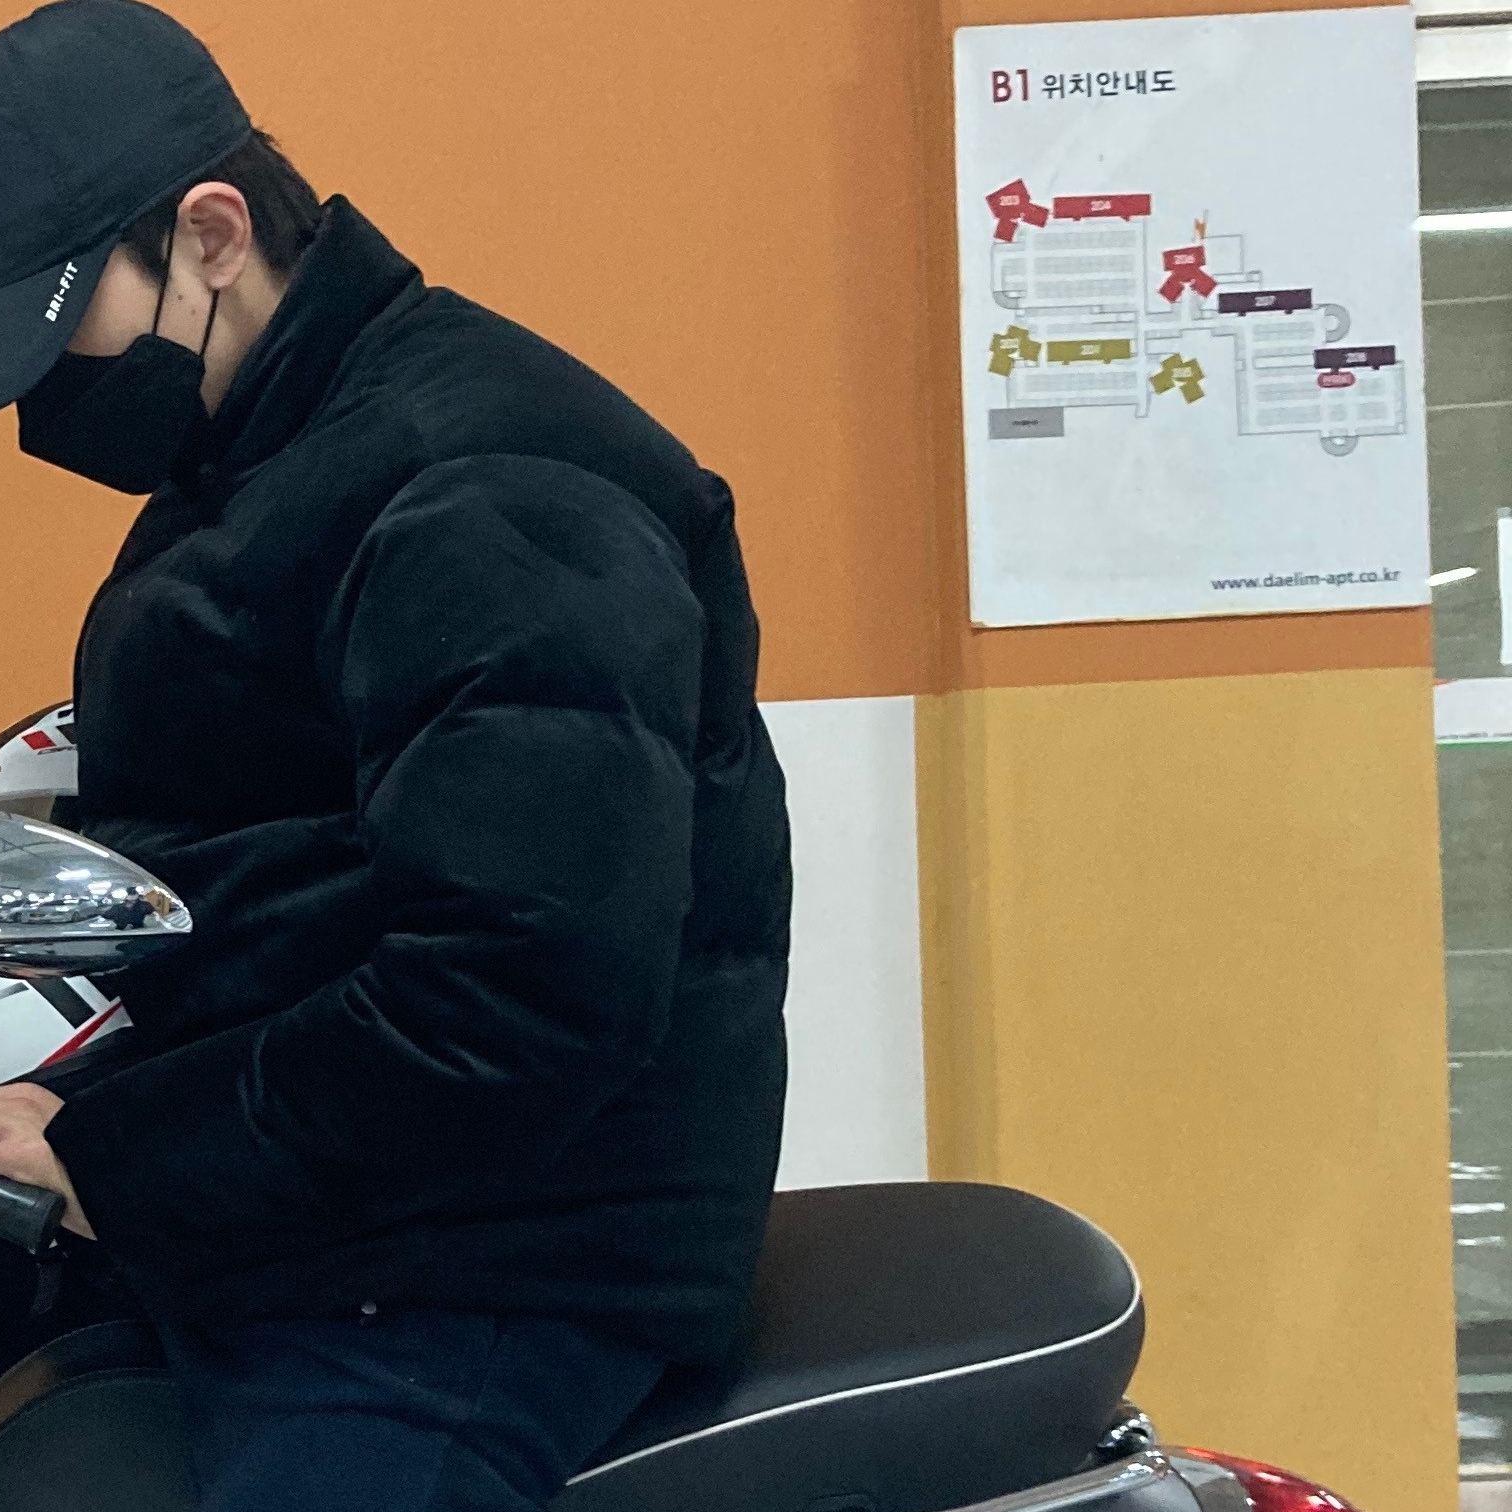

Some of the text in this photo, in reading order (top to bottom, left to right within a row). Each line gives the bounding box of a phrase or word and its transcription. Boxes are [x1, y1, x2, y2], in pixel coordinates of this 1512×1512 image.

[991, 68, 1178, 104] B1 위치안내도
[45, 261, 78, 322] DRI-FIT
[1210, 566, 1402, 591] www.daelim-apt.co.kr
